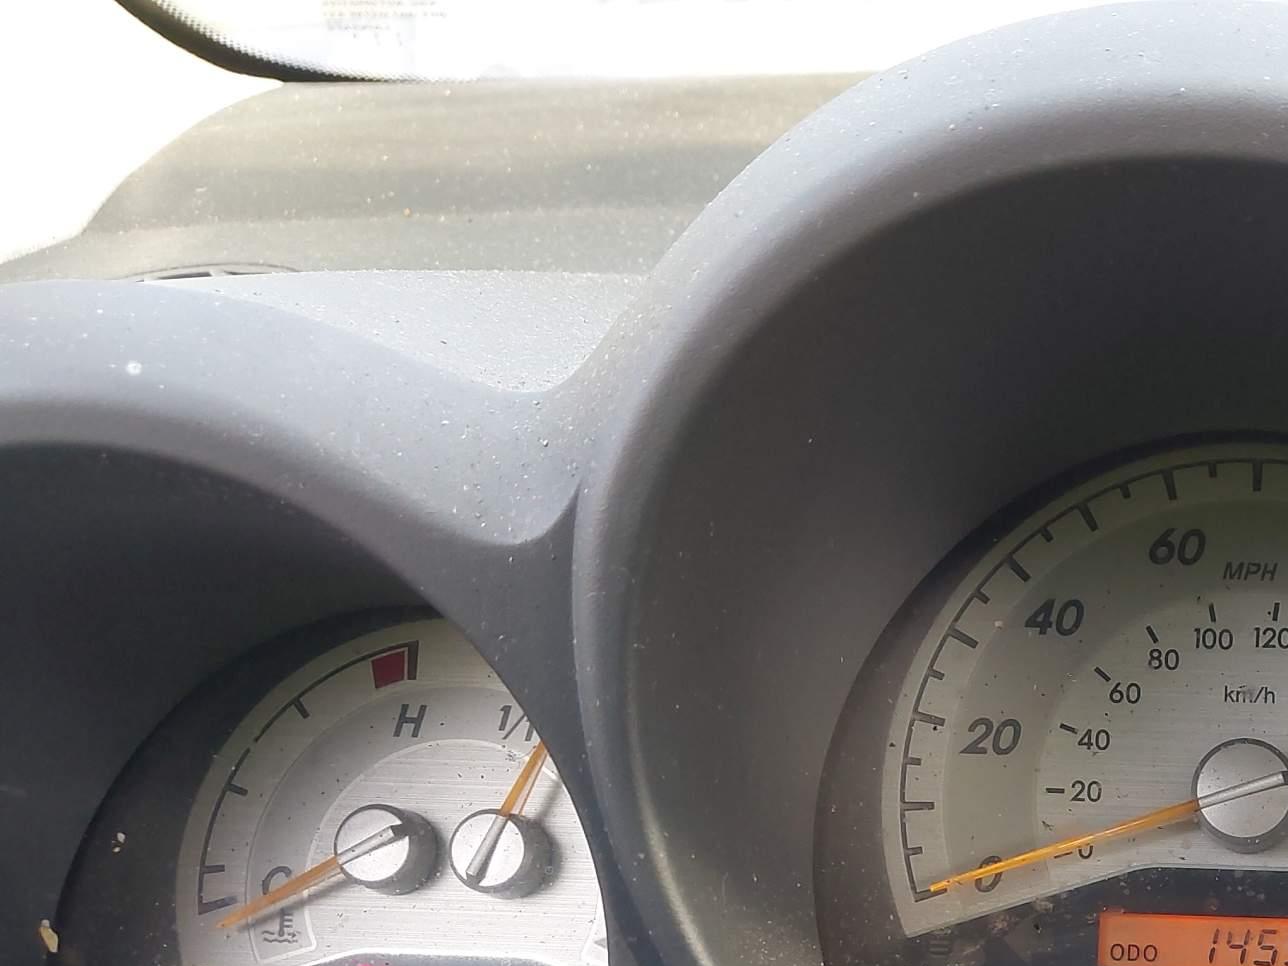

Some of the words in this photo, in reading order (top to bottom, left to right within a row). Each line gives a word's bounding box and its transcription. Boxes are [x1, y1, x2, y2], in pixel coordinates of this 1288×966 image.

[1149, 527, 1206, 566] 60
[1223, 561, 1278, 582] MPH
[1024, 598, 1084, 636] 40
[1194, 627, 1234, 650] 100
[1148, 648, 1180, 671] 80
[1109, 682, 1141, 704] 60
[392, 704, 427, 738] H
[959, 717, 1022, 755] 20
[1077, 728, 1110, 751] 40
[1069, 780, 1102, 803] 20
[974, 855, 1003, 893] 0
[1109, 943, 1158, 962] ODO
